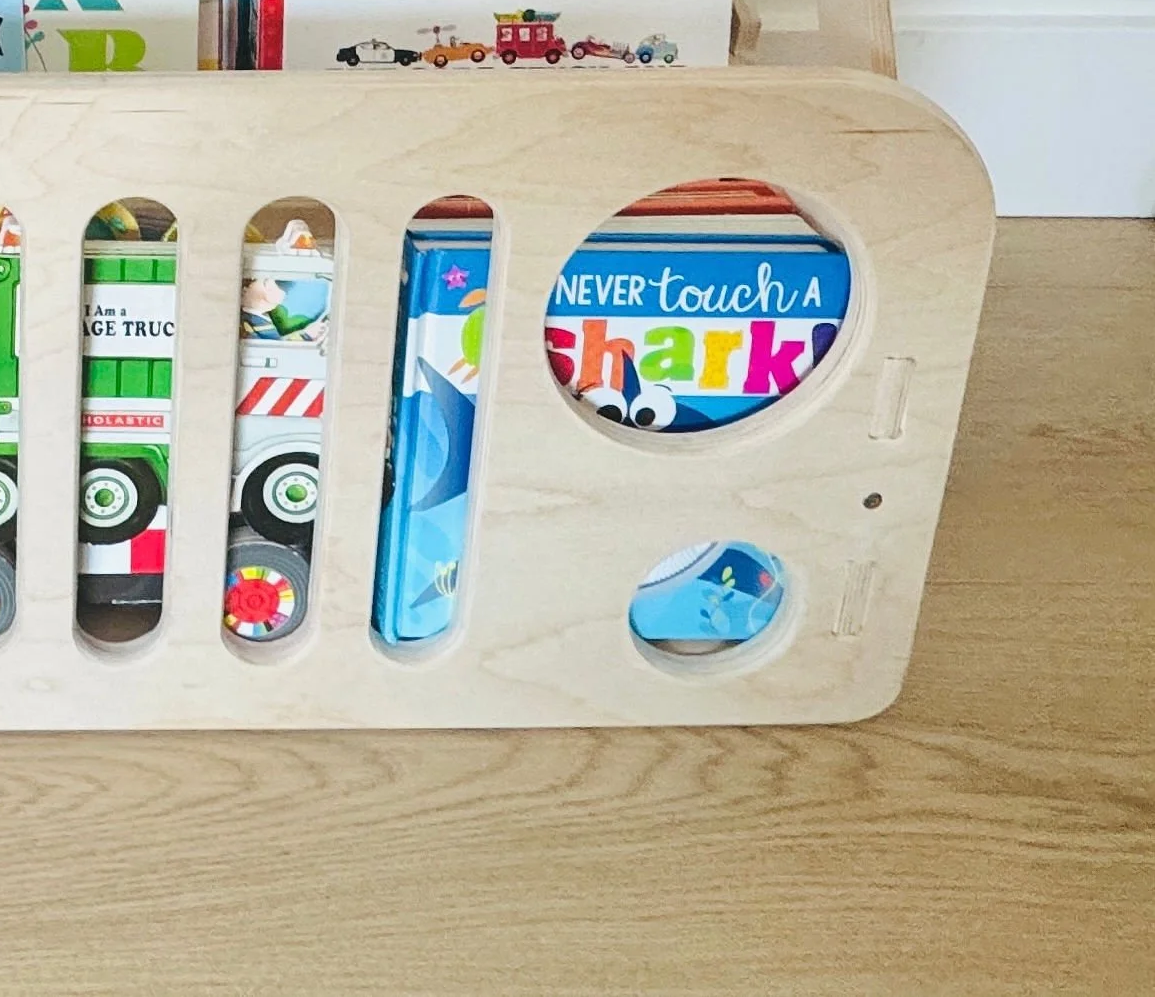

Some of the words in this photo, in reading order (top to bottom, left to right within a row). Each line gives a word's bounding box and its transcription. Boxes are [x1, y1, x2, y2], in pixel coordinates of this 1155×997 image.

[555, 274, 644, 307] NEVER
[649, 262, 800, 314] touch
[802, 276, 822, 308] A
[94, 304, 116, 317] Am
[120, 307, 127, 317] a
[122, 320, 175, 338] TRUC
